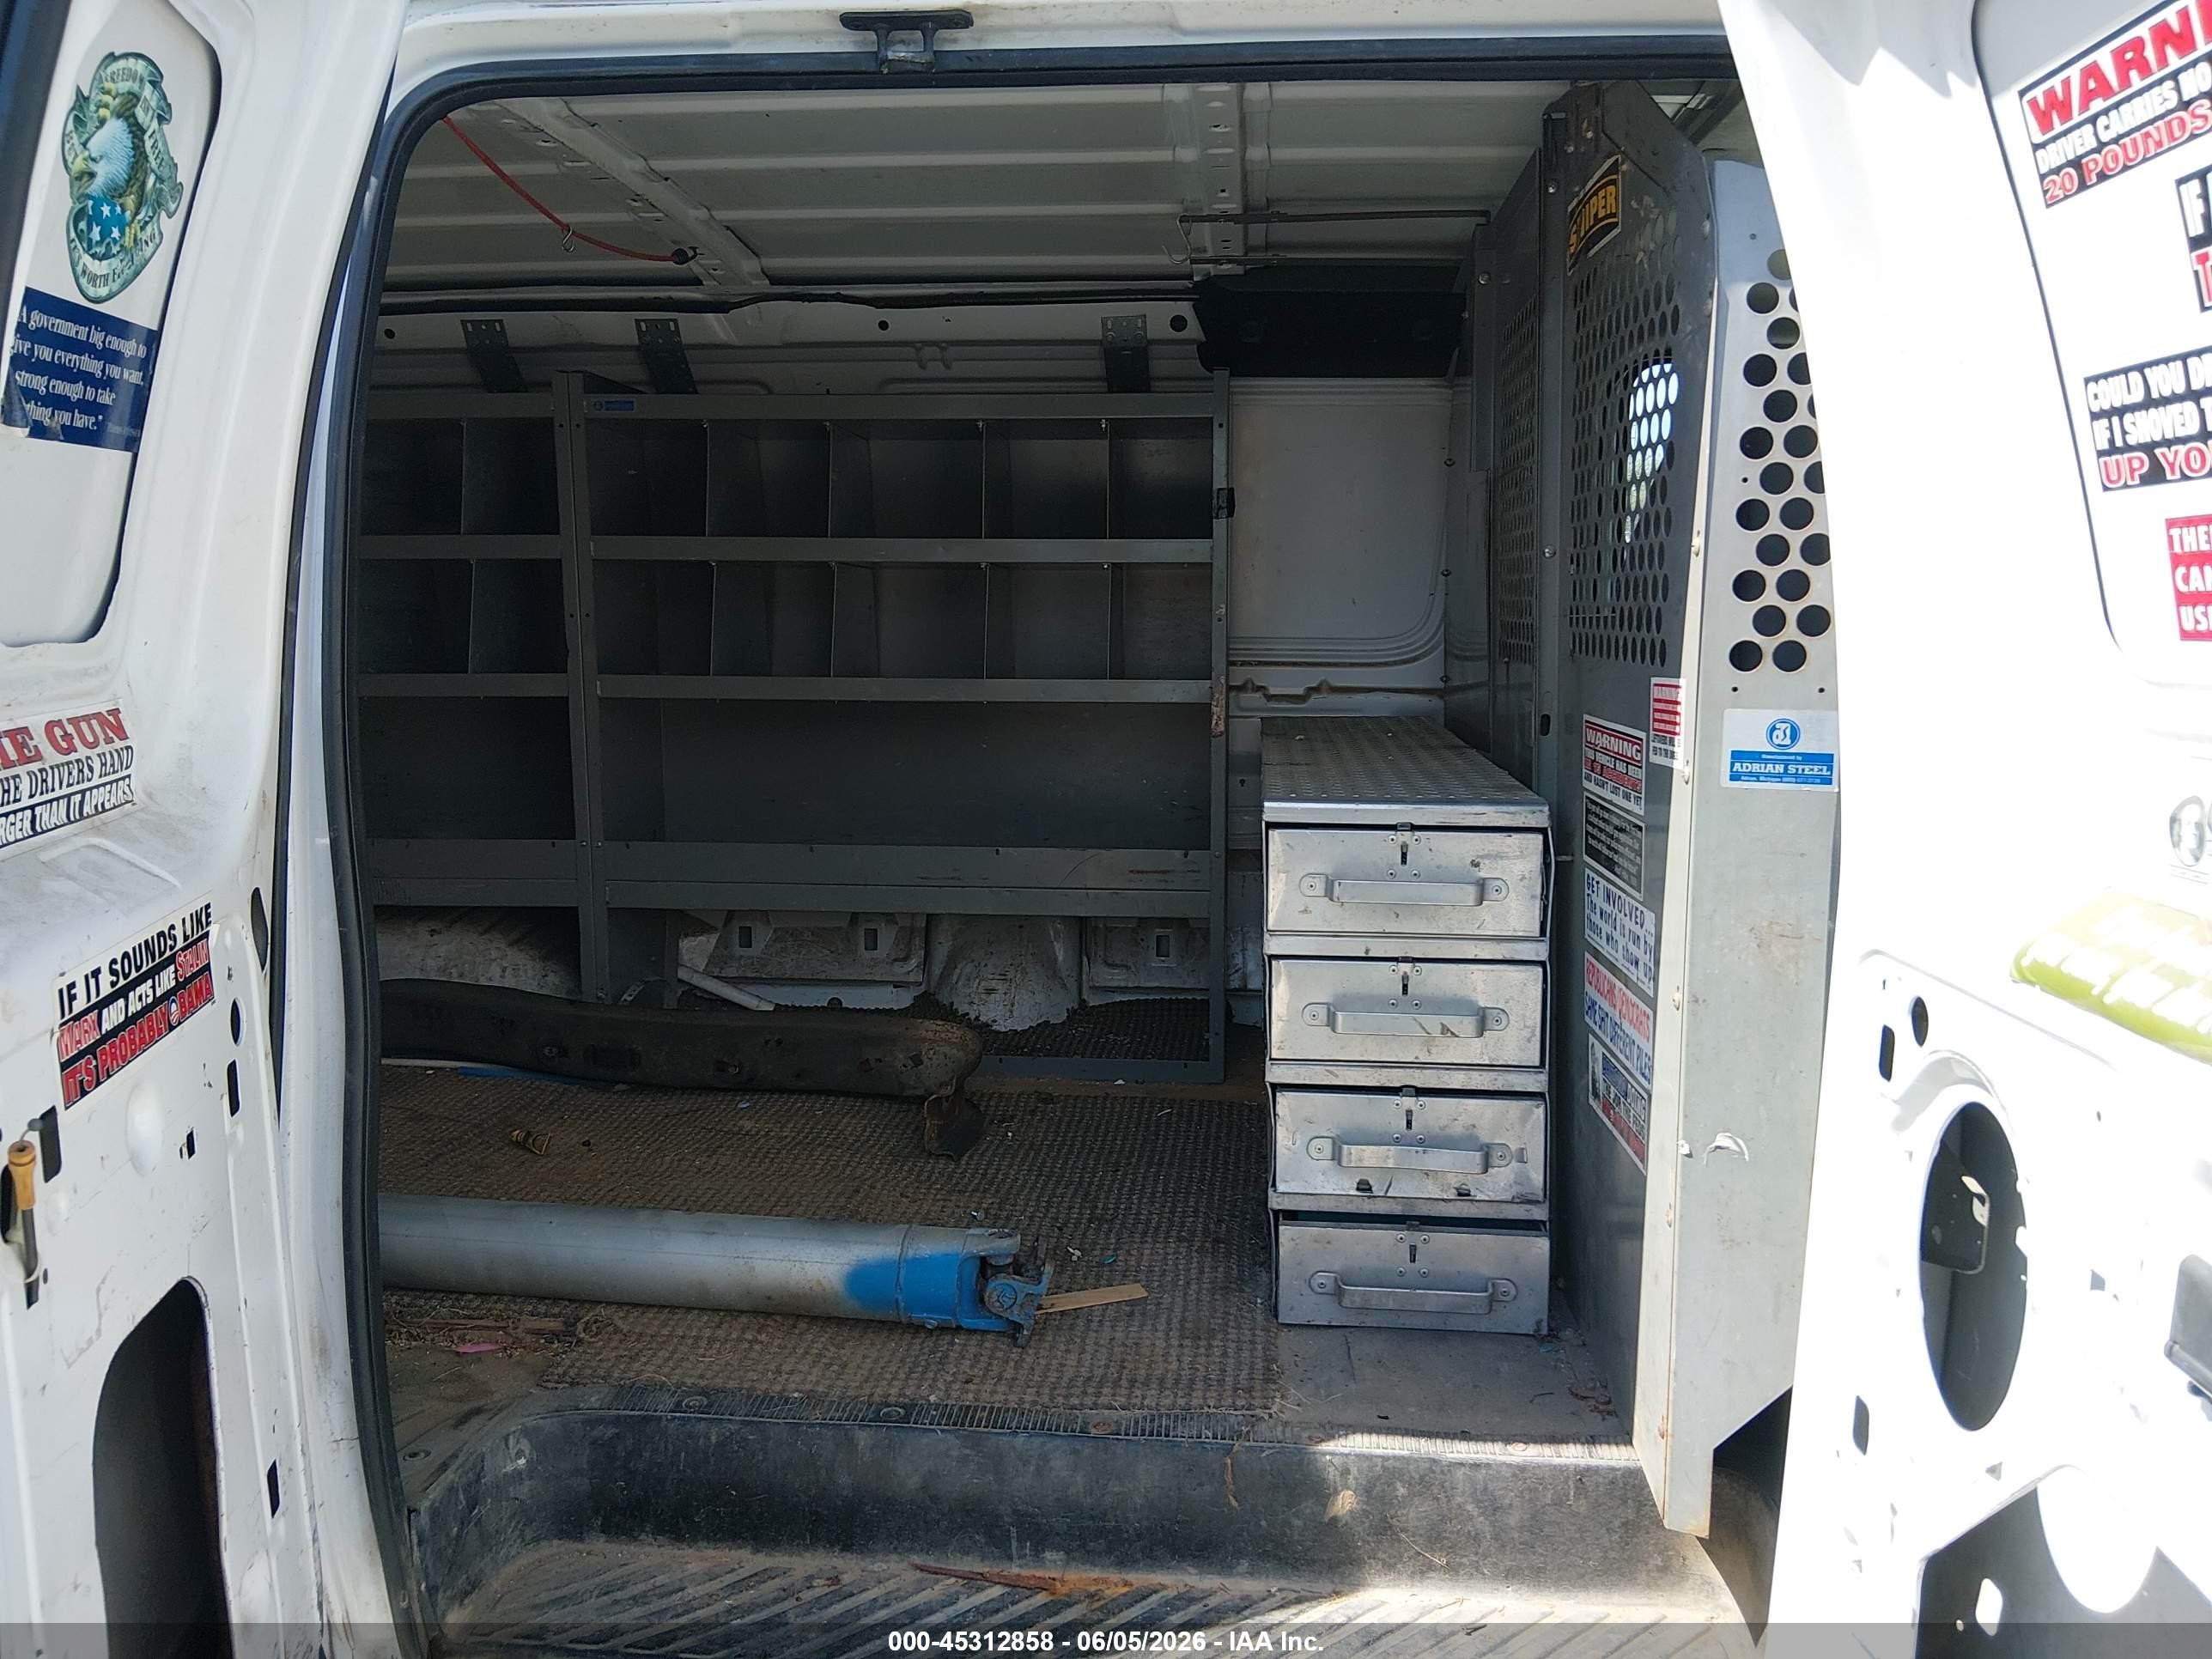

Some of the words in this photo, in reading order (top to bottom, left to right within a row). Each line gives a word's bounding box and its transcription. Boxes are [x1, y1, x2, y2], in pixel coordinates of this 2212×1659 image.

[2036, 123, 2097, 174] DRIVER
[2096, 80, 2179, 143] CARRIES
[2043, 167, 2078, 204] 20
[2081, 99, 2212, 185] POUNDS
[81, 262, 110, 289] WORTH
[28, 309, 89, 342] government
[89, 325, 105, 349] big
[106, 334, 137, 358] enough
[137, 341, 147, 359] to
[32, 343, 52, 362] you
[54, 349, 103, 379] everything
[103, 363, 121, 380] you
[15, 370, 49, 395] strong
[49, 378, 84, 402] enough
[85, 385, 95, 403] to
[96, 386, 117, 406] take
[2087, 371, 2145, 414] COULD
[2144, 360, 2186, 399] YOU
[53, 410, 72, 426] you
[2092, 417, 2112, 451] IF
[2113, 416, 2123, 447] I
[2123, 401, 2201, 447] SHOVED
[2100, 452, 2149, 488] UP
[2154, 441, 2212, 481] YO
[2169, 524, 2212, 554] THE
[44, 708, 129, 756] GUN
[1586, 728, 1642, 761] WARNING
[27, 755, 95, 799] DRIVERS
[96, 744, 134, 779] HAND
[1593, 775, 1609, 793] HASN'T
[1610, 782, 1621, 798] LOST
[1622, 788, 1632, 802] ONE
[1615, 758, 1627, 774] HAS
[1733, 763, 1784, 774] ADRIAN
[1786, 764, 1831, 775] STEEL
[34, 797, 68, 832] THAN
[70, 793, 82, 822] IT
[83, 778, 133, 817] APPEARS
[1586, 873, 1600, 898] GET
[1586, 893, 1597, 918] The
[1599, 906, 1617, 932] world
[1620, 917, 1626, 939] is
[1628, 927, 1641, 951] run
[1644, 933, 1653, 963] by
[1586, 913, 1602, 940] those
[1606, 930, 1619, 954] who
[1622, 944, 1639, 972] show
[58, 980, 77, 1020] IF
[83, 966, 102, 1004] IT
[108, 923, 178, 989] SOUNDS
[181, 902, 212, 944] LIKE
[58, 1010, 101, 1062] MARX
[101, 997, 126, 1035] AND
[128, 976, 155, 1017] ACTS
[155, 963, 177, 998] LIKE
[63, 1054, 96, 1107] IT'S
[96, 1001, 169, 1081] PROBABLY
[1636, 1043, 1651, 1085] PILES
